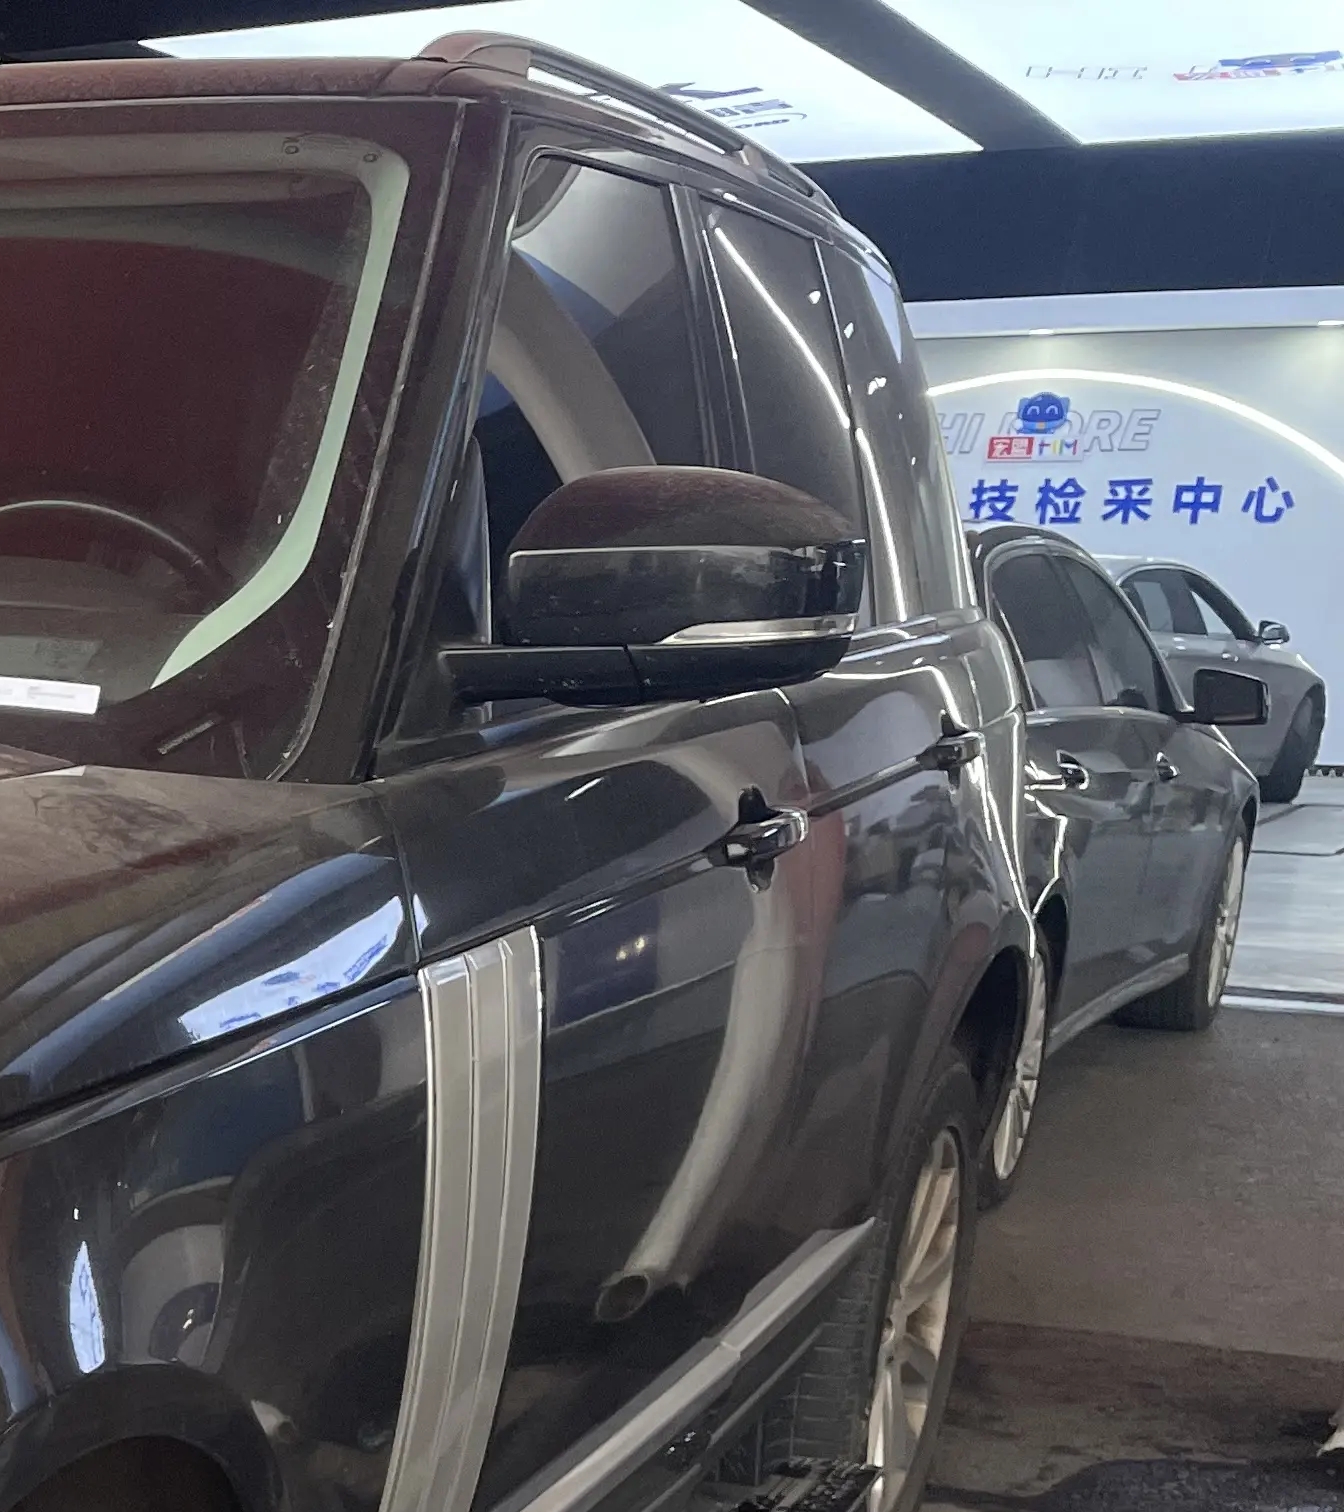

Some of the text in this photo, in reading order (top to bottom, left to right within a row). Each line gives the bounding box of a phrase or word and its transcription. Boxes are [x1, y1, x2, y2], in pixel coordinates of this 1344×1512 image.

[969, 476, 1295, 525] 技检采中心
